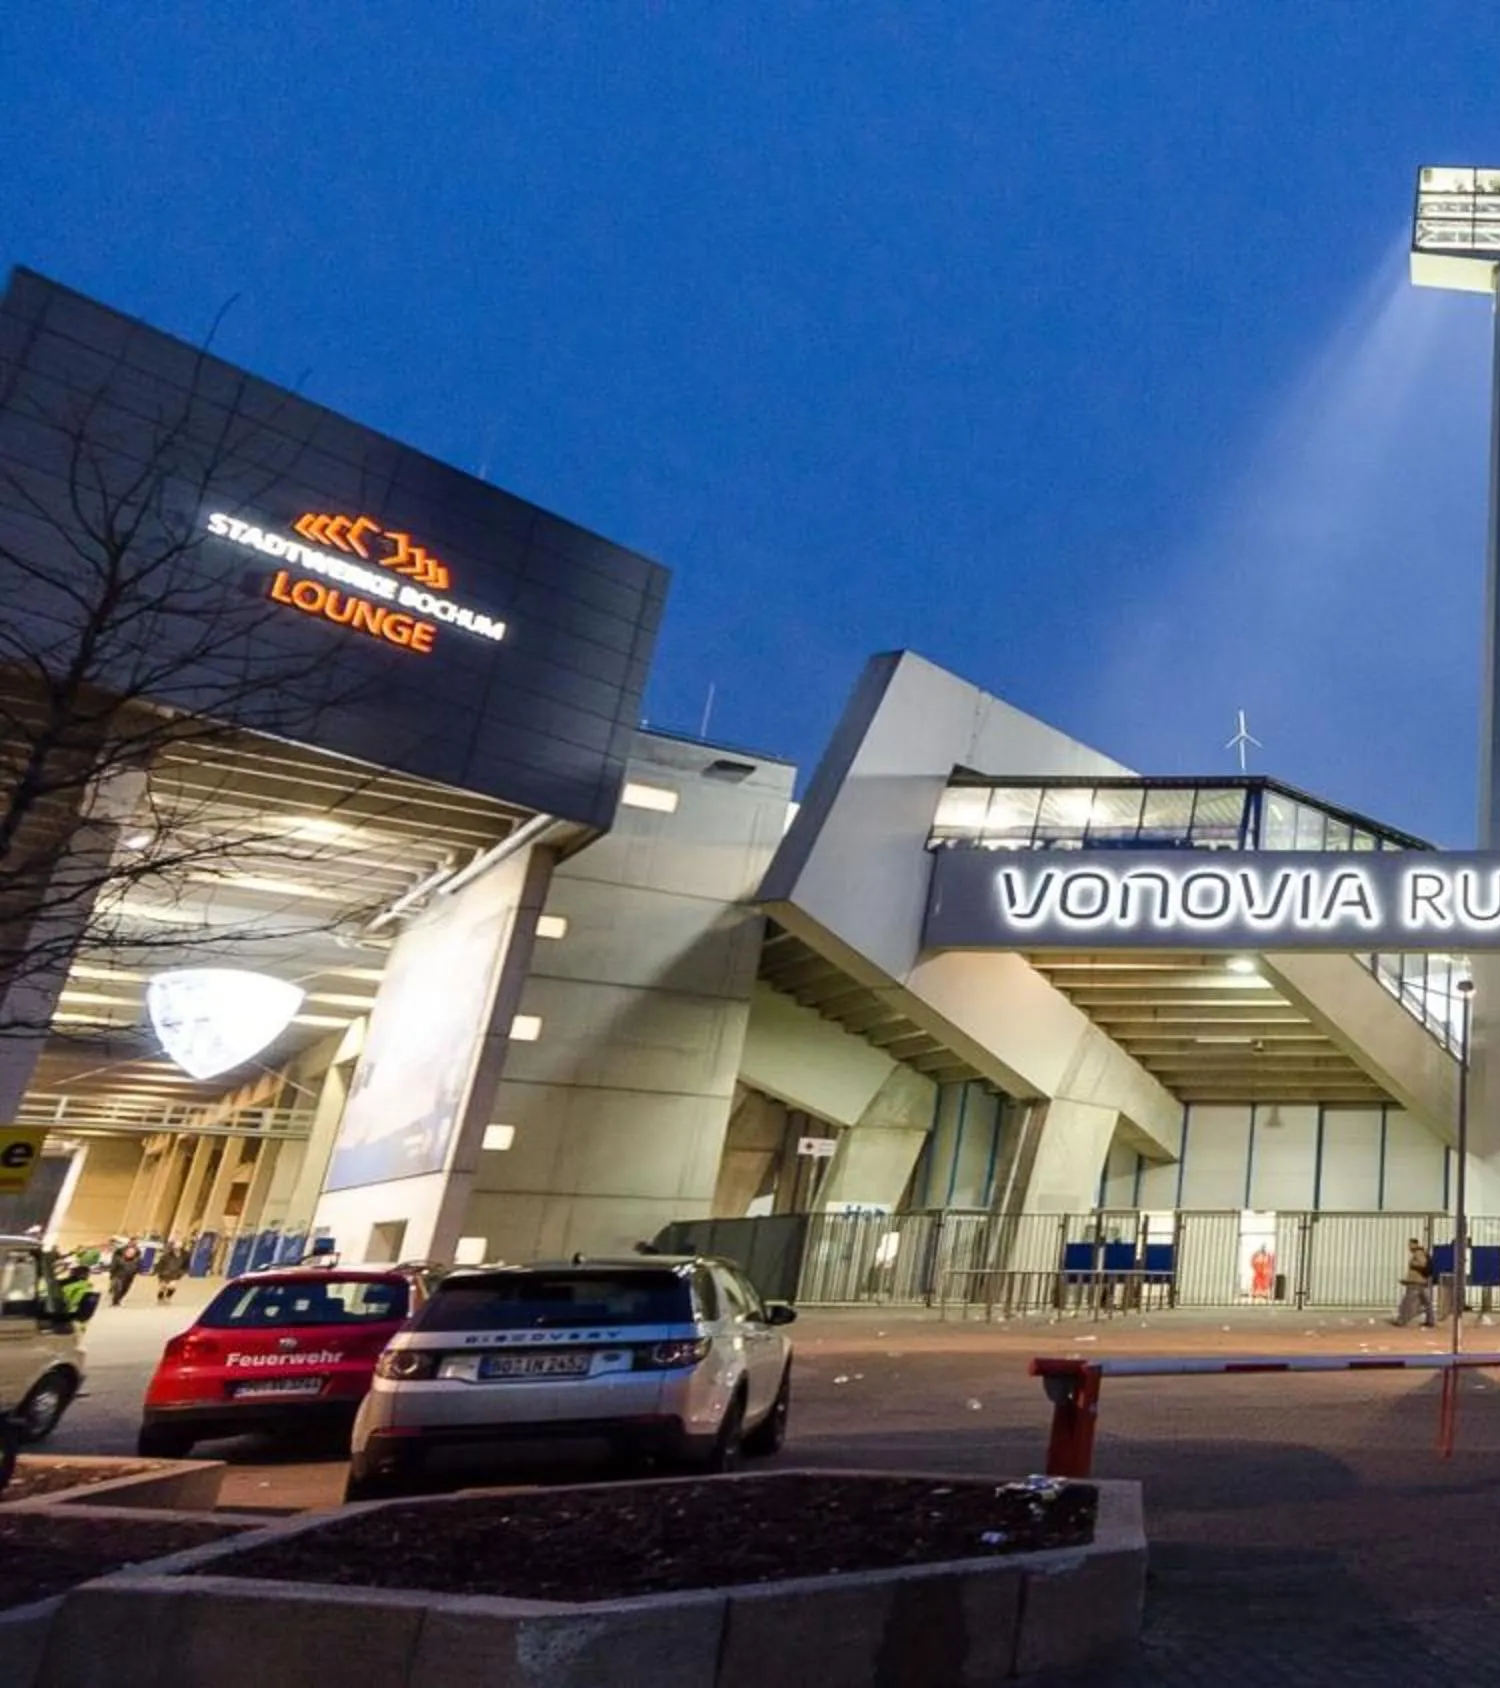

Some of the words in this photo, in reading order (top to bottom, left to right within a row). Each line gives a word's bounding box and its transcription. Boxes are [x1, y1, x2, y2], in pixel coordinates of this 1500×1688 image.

[206, 512, 399, 600] STADTWERKE
[398, 585, 507, 642] BOCHUM
[270, 569, 439, 653] LOUNGE
[1001, 871, 1375, 922] VONOVIA
[225, 1350, 344, 1367] Feuerwehr
